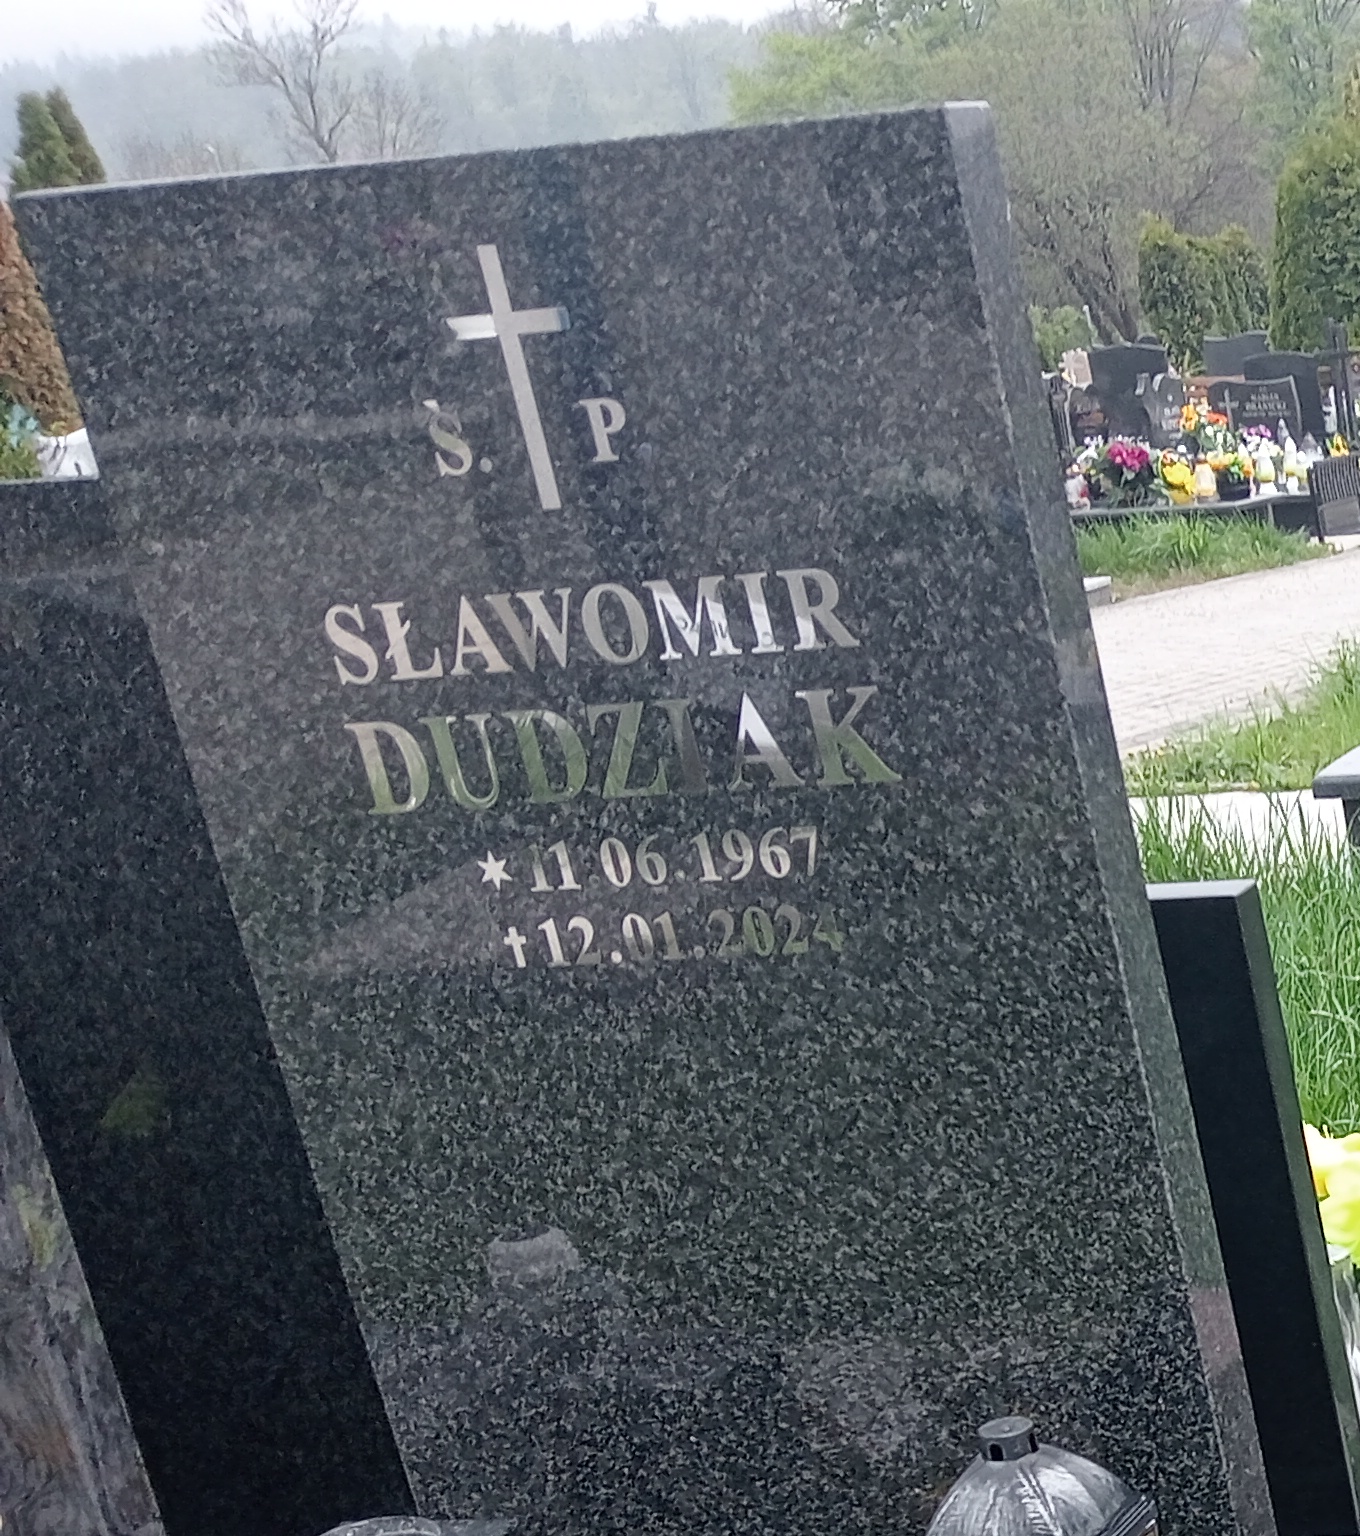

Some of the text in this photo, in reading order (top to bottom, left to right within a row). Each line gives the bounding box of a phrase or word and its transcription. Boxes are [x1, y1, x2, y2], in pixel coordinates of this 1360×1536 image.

[324, 566, 860, 686] SŁAWOMIR
[344, 684, 902, 816] DUDZIAK
[537, 903, 846, 969] 12.01.2024
